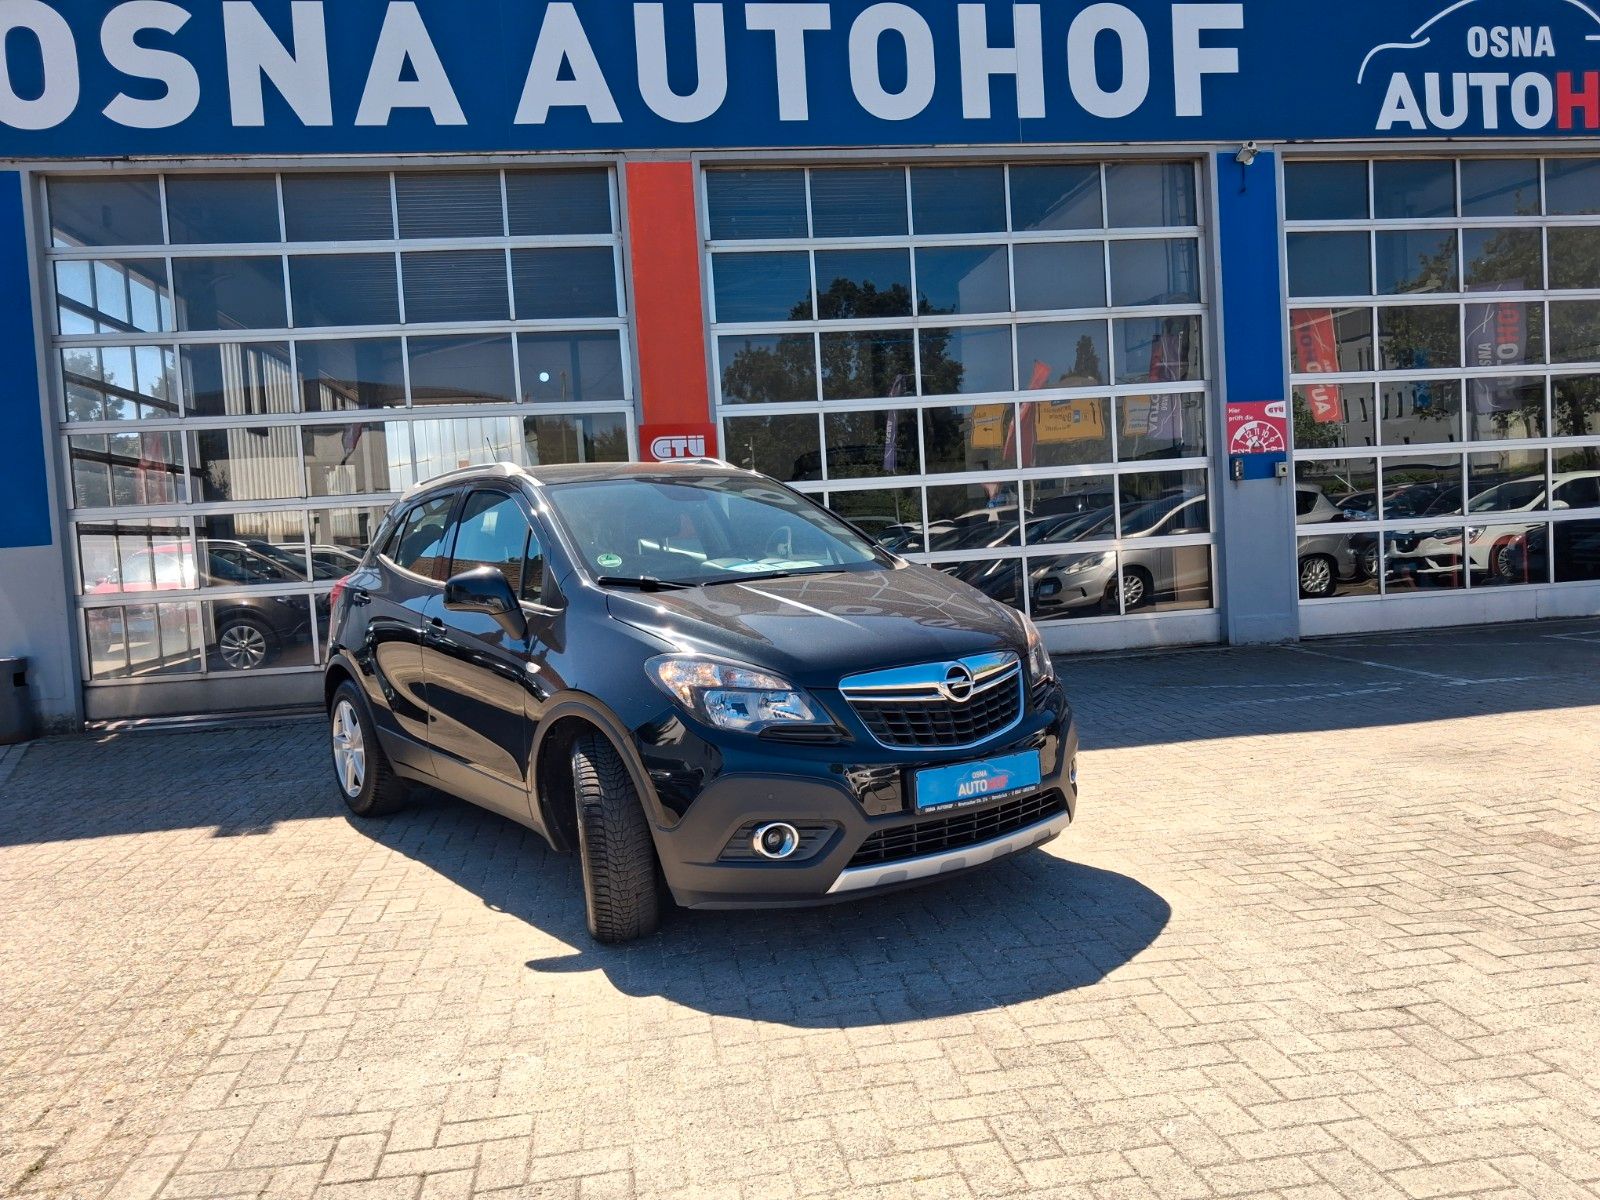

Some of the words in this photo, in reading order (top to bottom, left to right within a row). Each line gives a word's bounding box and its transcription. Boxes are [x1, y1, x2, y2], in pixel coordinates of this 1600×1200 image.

[1467, 25, 1556, 58] OSNA
[0, 0, 468, 131] OSNA
[513, 2, 1244, 125] AUTOHOF
[1376, 71, 1599, 130] AUTOH
[651, 434, 706, 459] GTÜ
[1244, 430, 1253, 438] 12
[1261, 429, 1269, 438] 10
